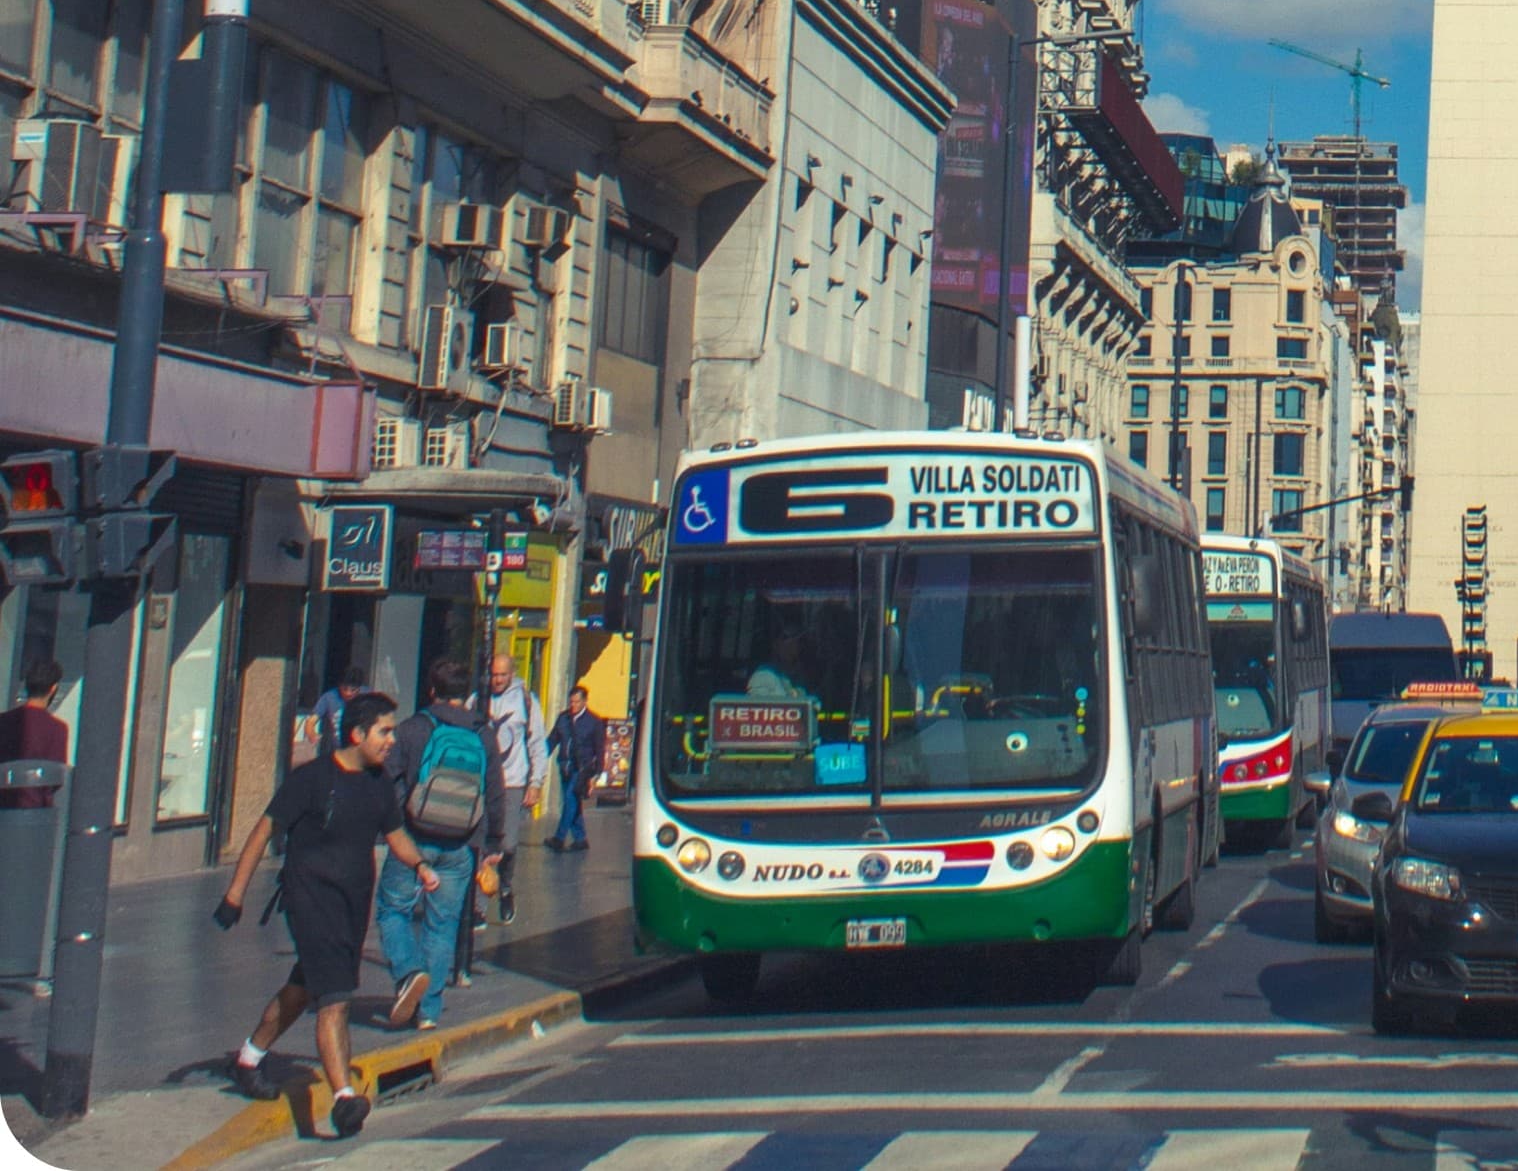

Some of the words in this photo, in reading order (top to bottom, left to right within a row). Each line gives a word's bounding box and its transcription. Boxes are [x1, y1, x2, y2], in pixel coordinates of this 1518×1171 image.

[909, 465, 976, 494] VILLA
[981, 464, 1080, 493] SOLDATI
[738, 466, 895, 536] 6
[908, 499, 1080, 529] RETIRO
[328, 558, 383, 575] Claus
[719, 707, 802, 721] RETIRO
[739, 723, 800, 738] BRASIL
[819, 754, 861, 772] SUBE
[979, 811, 1053, 829] AGRALE
[752, 862, 824, 883] NUDO
[894, 860, 933, 877] 4284
